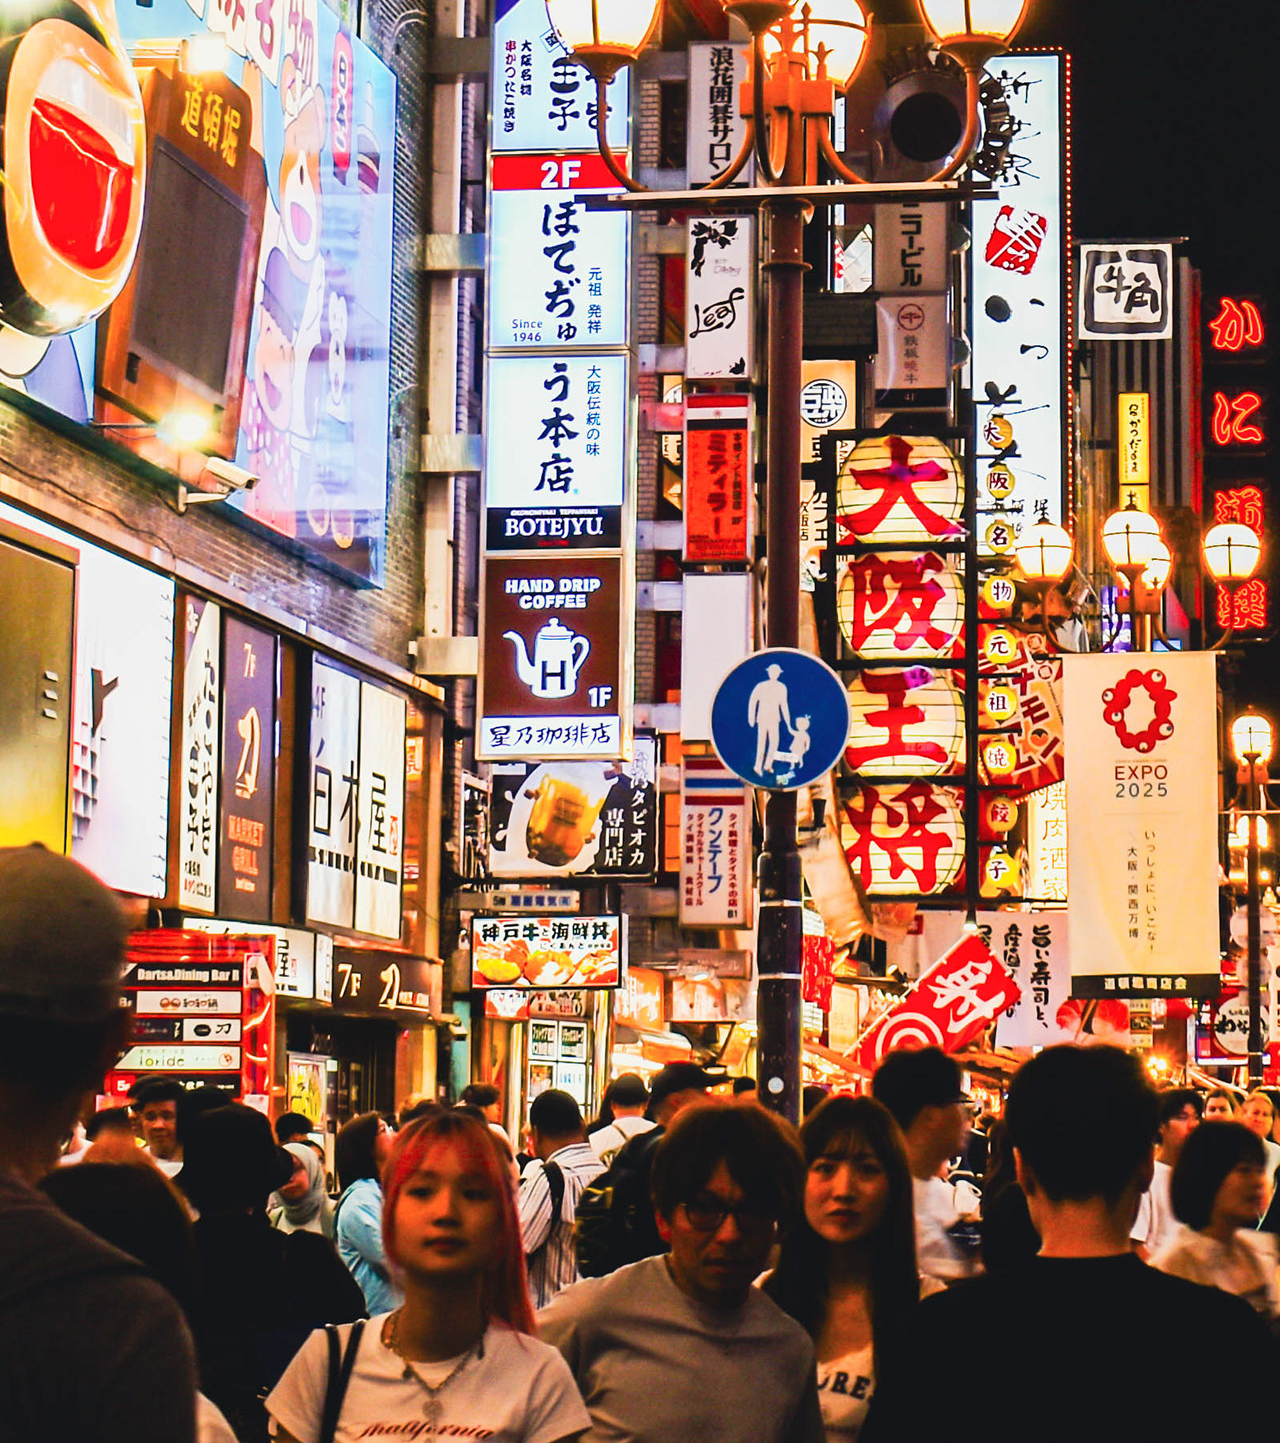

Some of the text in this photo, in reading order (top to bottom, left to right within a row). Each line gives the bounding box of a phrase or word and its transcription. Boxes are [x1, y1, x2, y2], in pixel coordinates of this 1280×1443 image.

[540, 161, 582, 189] 2F
[901, 204, 924, 286] ラービル
[587, 267, 603, 334] 元祖 発祥
[1096, 266, 1159, 315] 牛角
[512, 318, 543, 329] Since
[689, 287, 745, 339] Leaf
[513, 332, 542, 343] 1946
[586, 364, 602, 456] 大阪伝統の味
[505, 578, 602, 594] HAND DRIP
[519, 593, 587, 609] COFFEE
[541, 661, 567, 690] H
[835, 434, 970, 895] 大阪王将
[588, 686, 614, 707] 1F
[489, 723, 613, 750] 星乃珈琲店
[1114, 765, 1168, 780] EXPO
[1115, 783, 1168, 798] 2025
[337, 962, 362, 998] 7F
